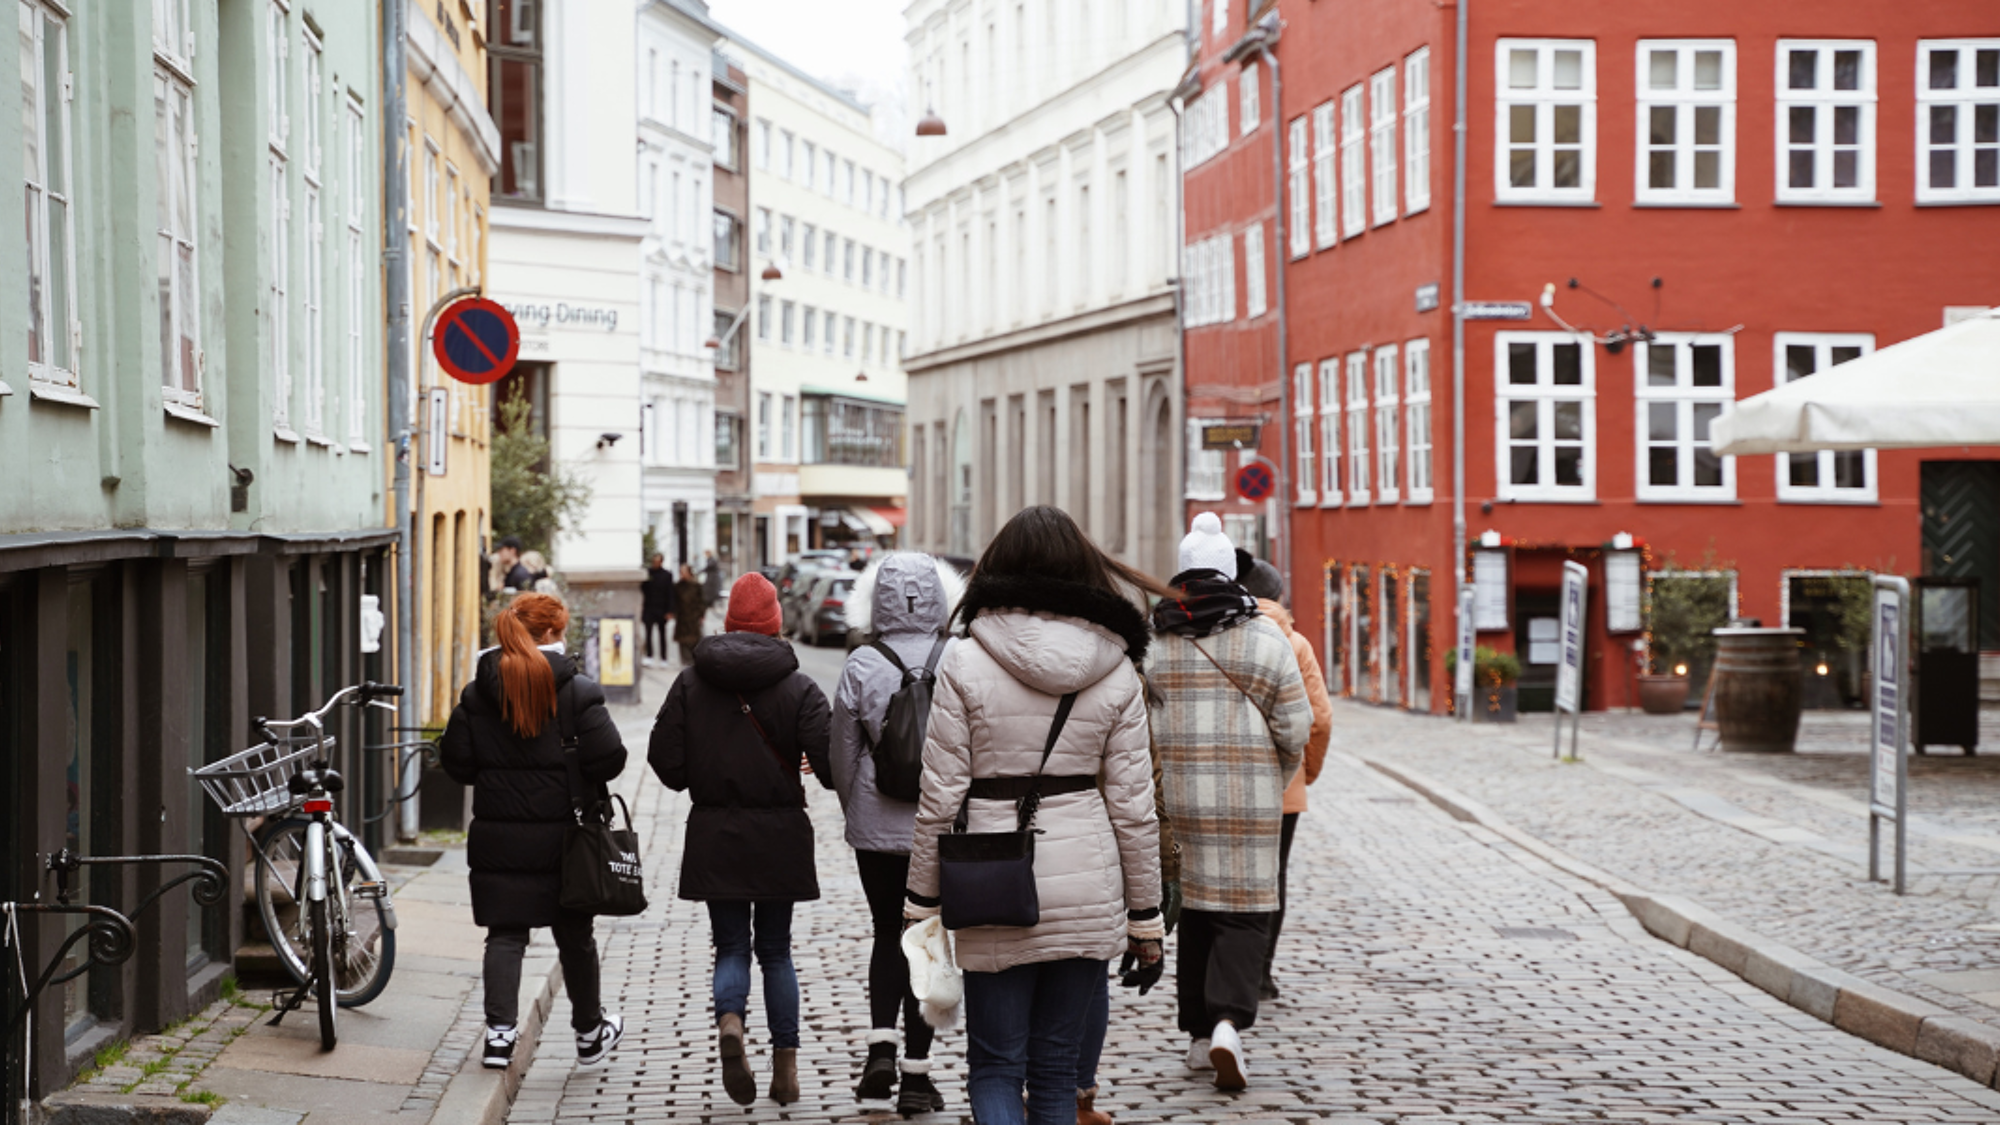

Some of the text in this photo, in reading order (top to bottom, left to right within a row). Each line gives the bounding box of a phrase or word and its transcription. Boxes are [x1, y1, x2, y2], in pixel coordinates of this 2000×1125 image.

[502, 302, 617, 332] ving Dining
[608, 860, 632, 875] TOTE
